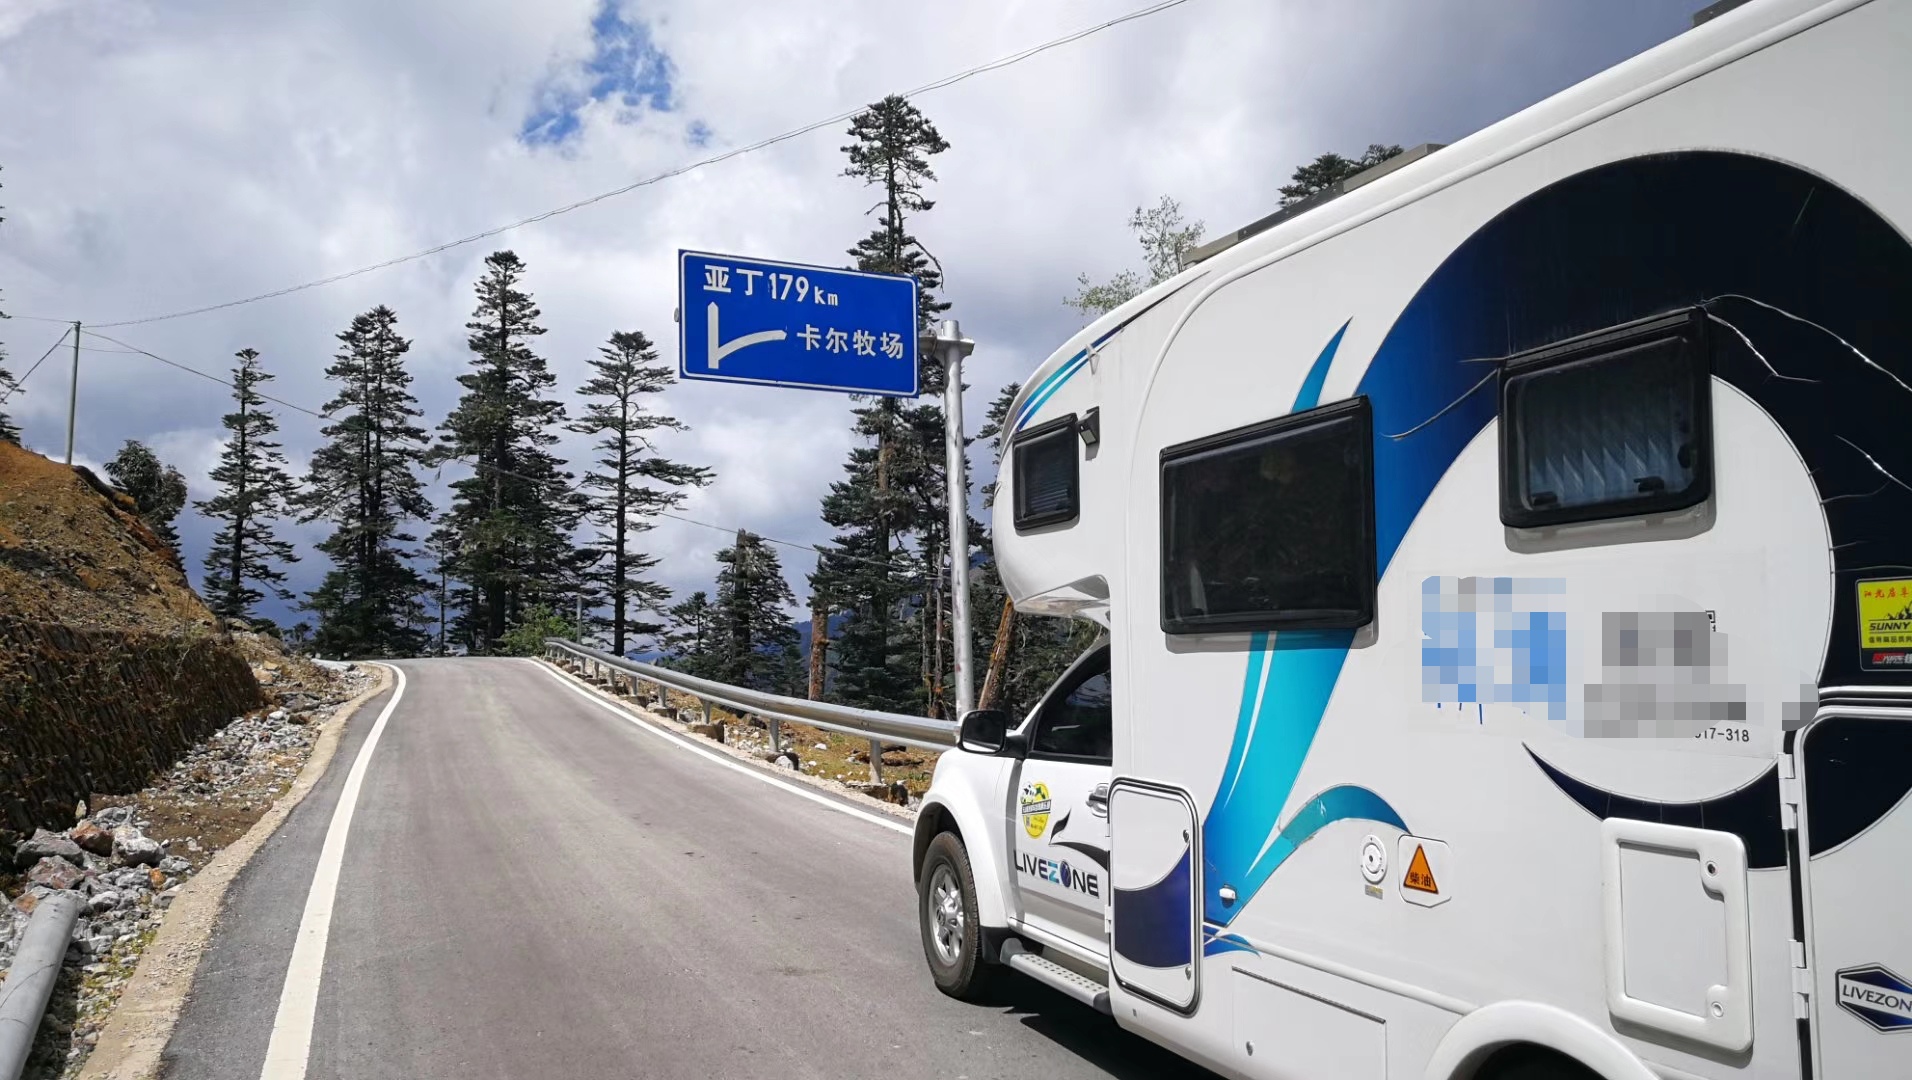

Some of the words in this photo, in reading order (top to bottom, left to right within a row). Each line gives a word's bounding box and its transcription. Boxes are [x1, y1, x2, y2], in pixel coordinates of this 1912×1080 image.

[797, 323, 904, 359] 卡尔牧场
[1869, 621, 1911, 632] SUNNY
[1014, 849, 1100, 898] LIVEZONE
[1409, 871, 1432, 887] 柴油
